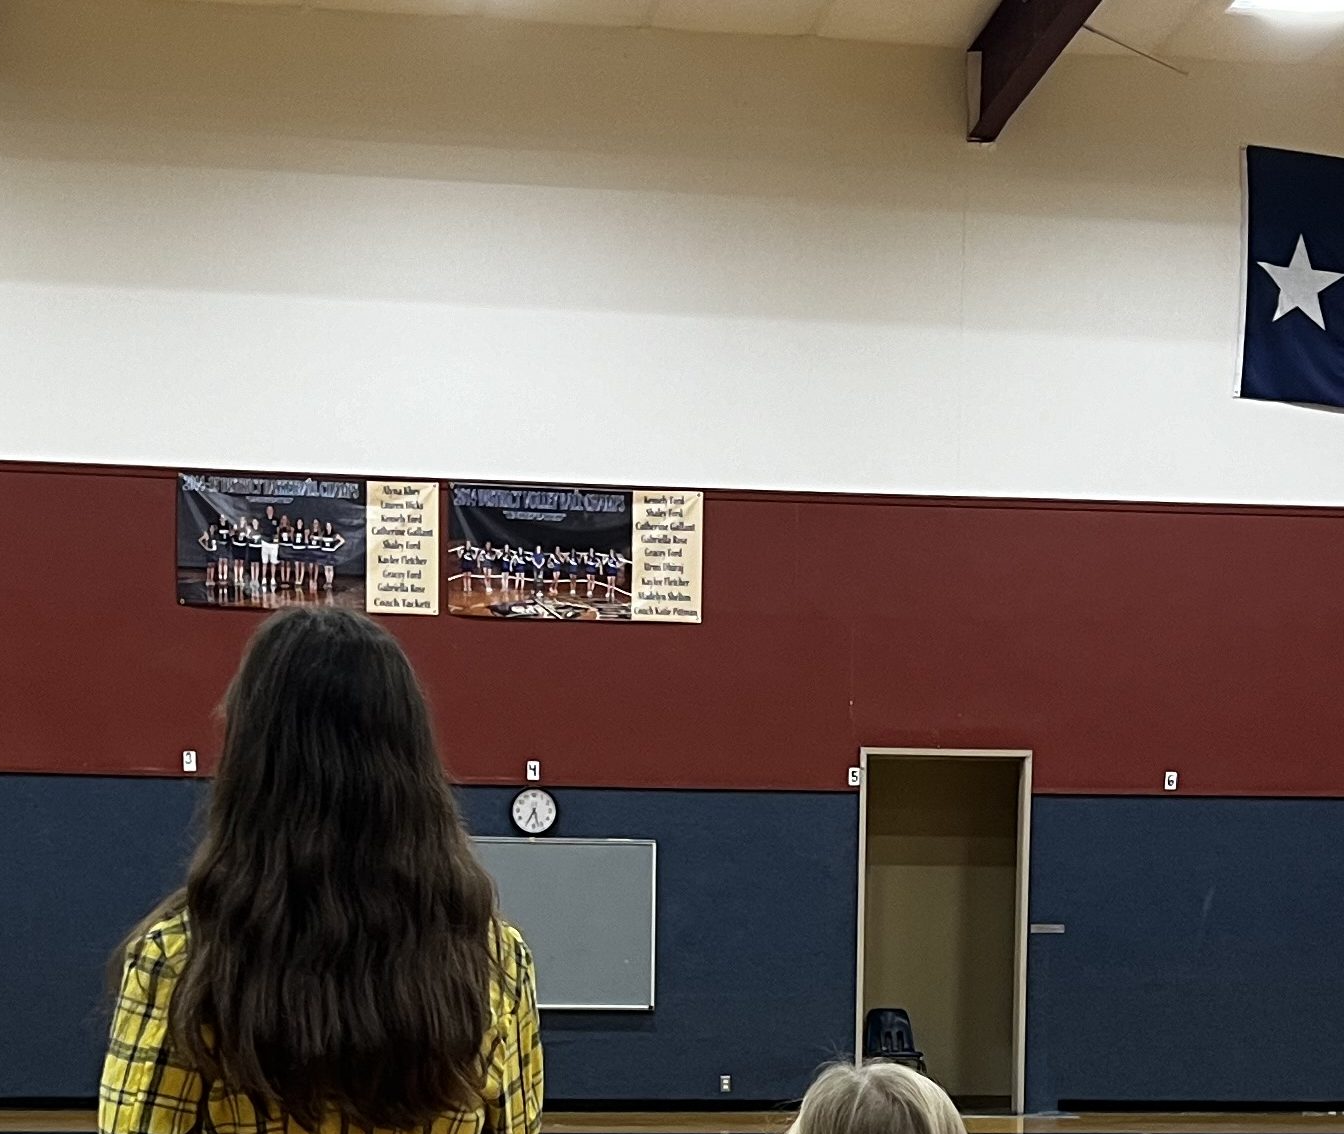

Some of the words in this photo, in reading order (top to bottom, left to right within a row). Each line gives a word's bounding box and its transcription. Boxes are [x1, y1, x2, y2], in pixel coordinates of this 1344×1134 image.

[185, 751, 193, 765] 3
[528, 764, 537, 777] 4
[851, 770, 859, 783] 5
[1167, 774, 1175, 787] 6
